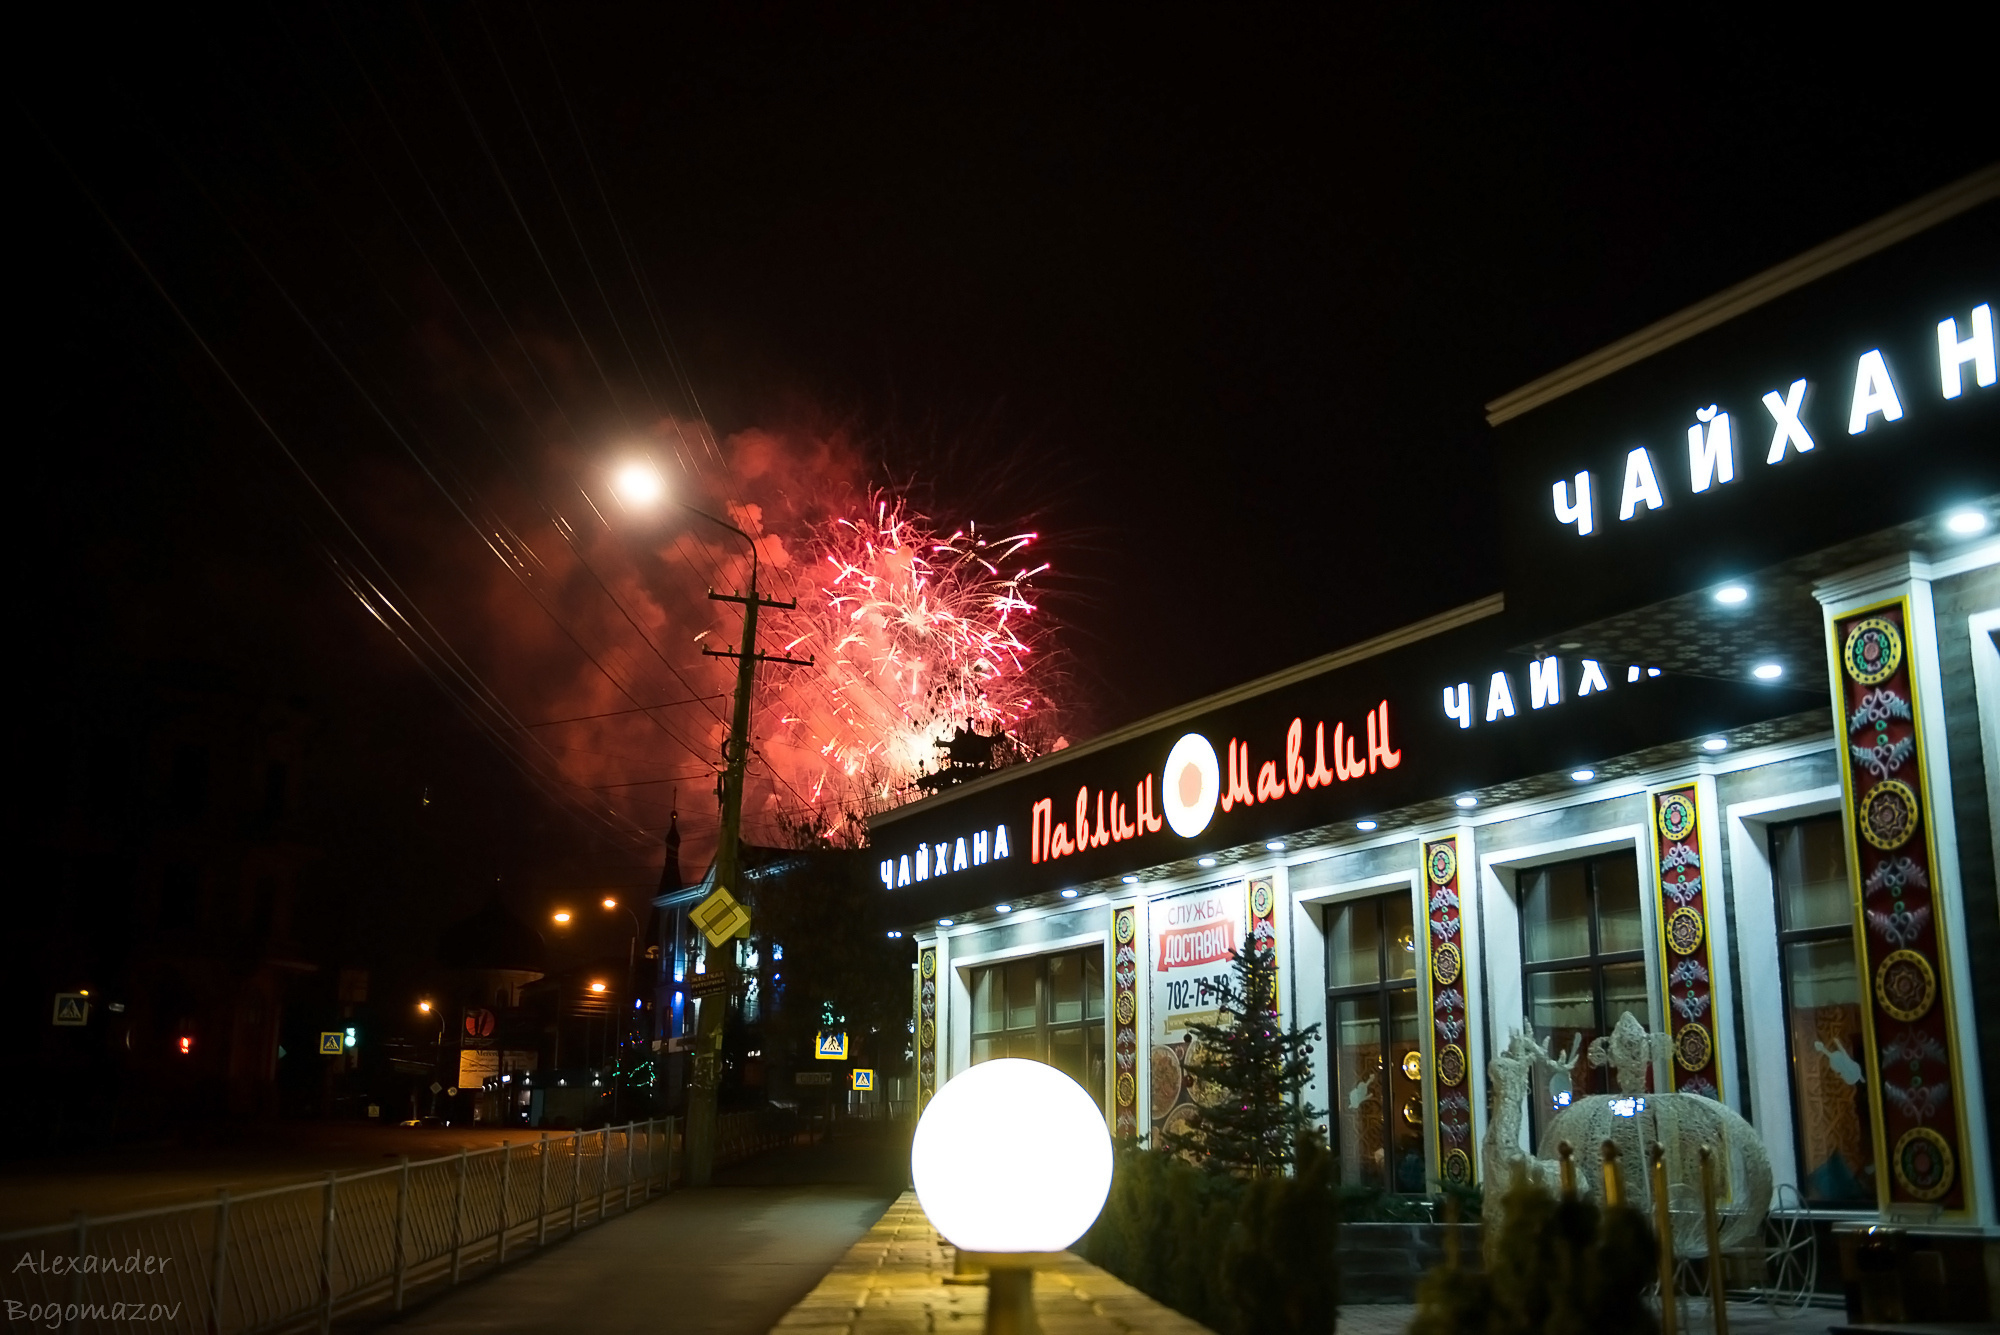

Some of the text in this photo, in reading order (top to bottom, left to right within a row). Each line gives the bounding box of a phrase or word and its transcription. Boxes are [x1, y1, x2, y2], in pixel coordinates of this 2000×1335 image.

[1552, 301, 1998, 536] ЧАЙХАН
[1031, 699, 1402, 864] Павлин Мавлин
[880, 824, 1009, 890] ЧАЙХАНА
[1168, 900, 1224, 925] СЛУЖБА
[1164, 926, 1230, 966] ДОСТАВКИ
